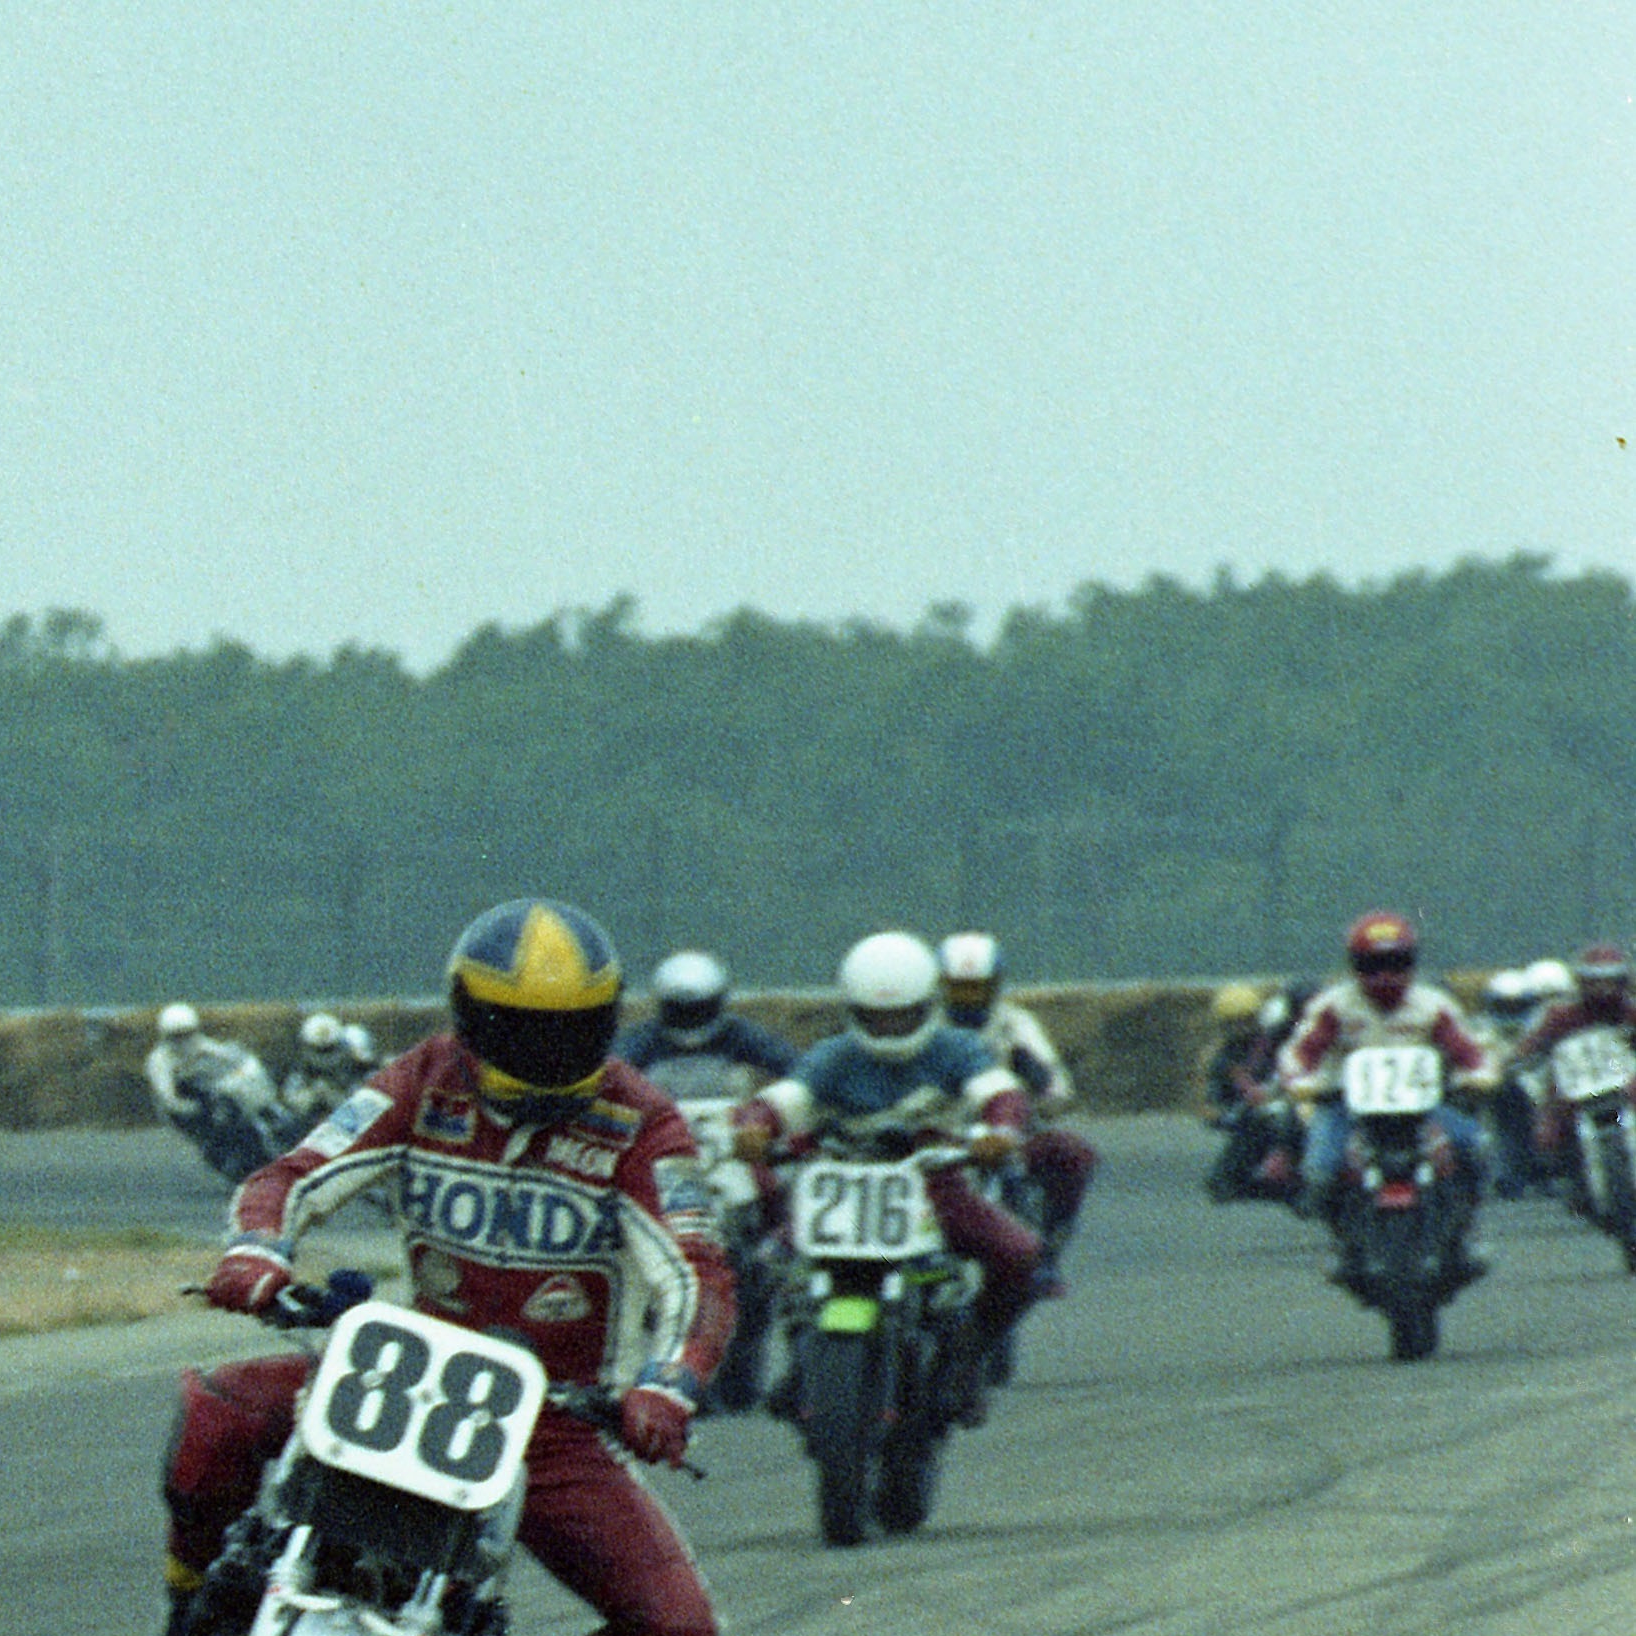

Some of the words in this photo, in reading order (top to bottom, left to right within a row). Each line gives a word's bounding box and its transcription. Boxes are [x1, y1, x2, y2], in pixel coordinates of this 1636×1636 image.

[401, 1166, 622, 1256] HONDA
[811, 1172, 909, 1246] 216
[326, 1319, 524, 1484] 88
